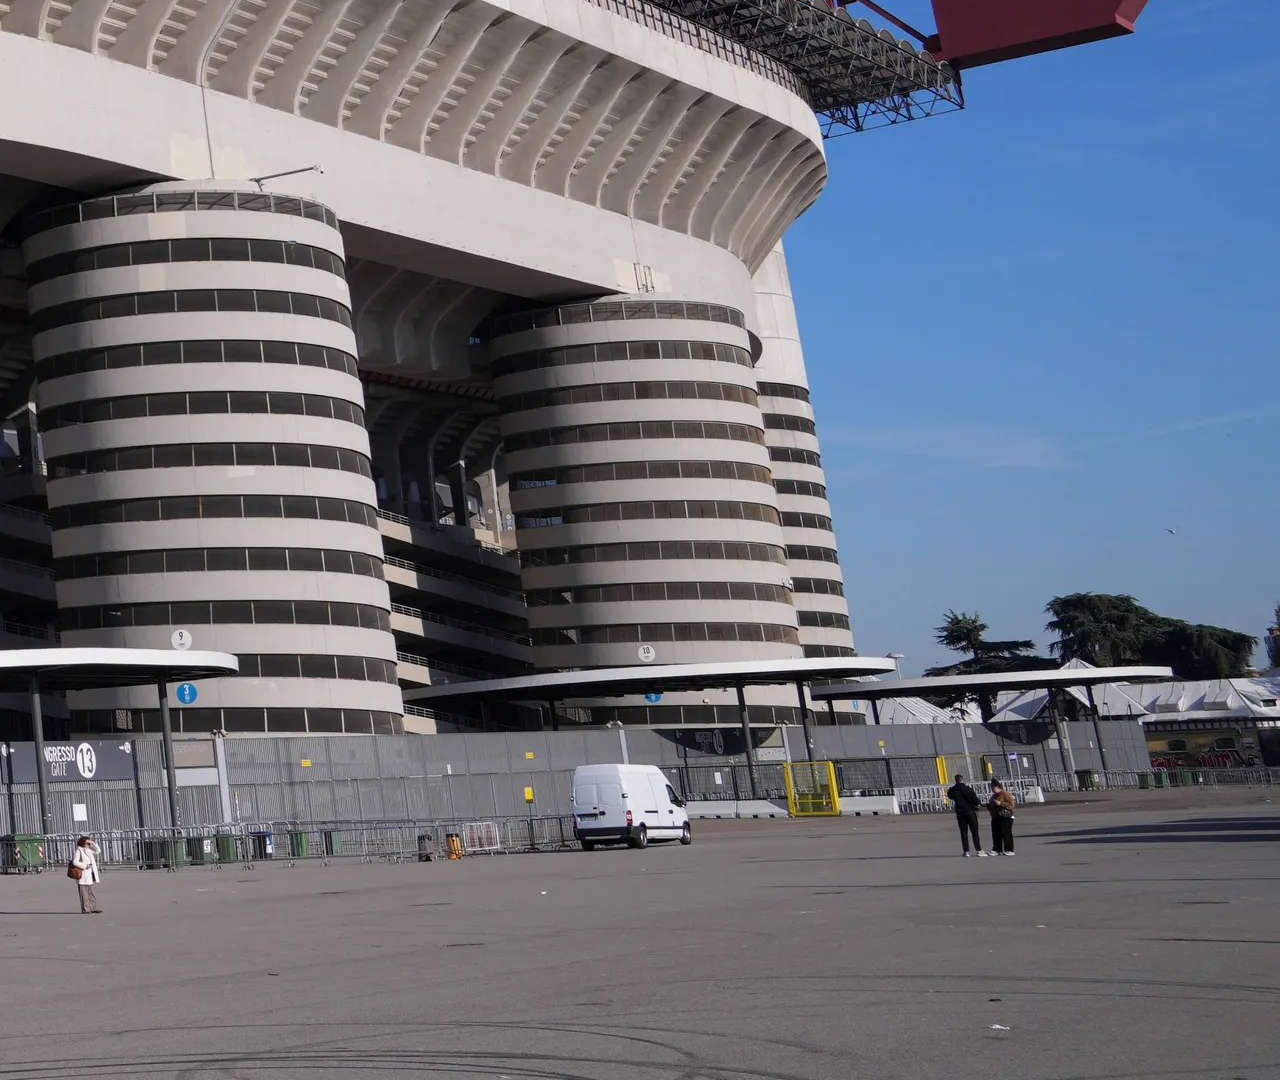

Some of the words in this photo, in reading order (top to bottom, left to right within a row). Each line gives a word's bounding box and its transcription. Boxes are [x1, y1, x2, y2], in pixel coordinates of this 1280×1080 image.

[642, 646, 651, 655] 10
[79, 747, 94, 774] 13
[51, 762, 67, 776] GATE
